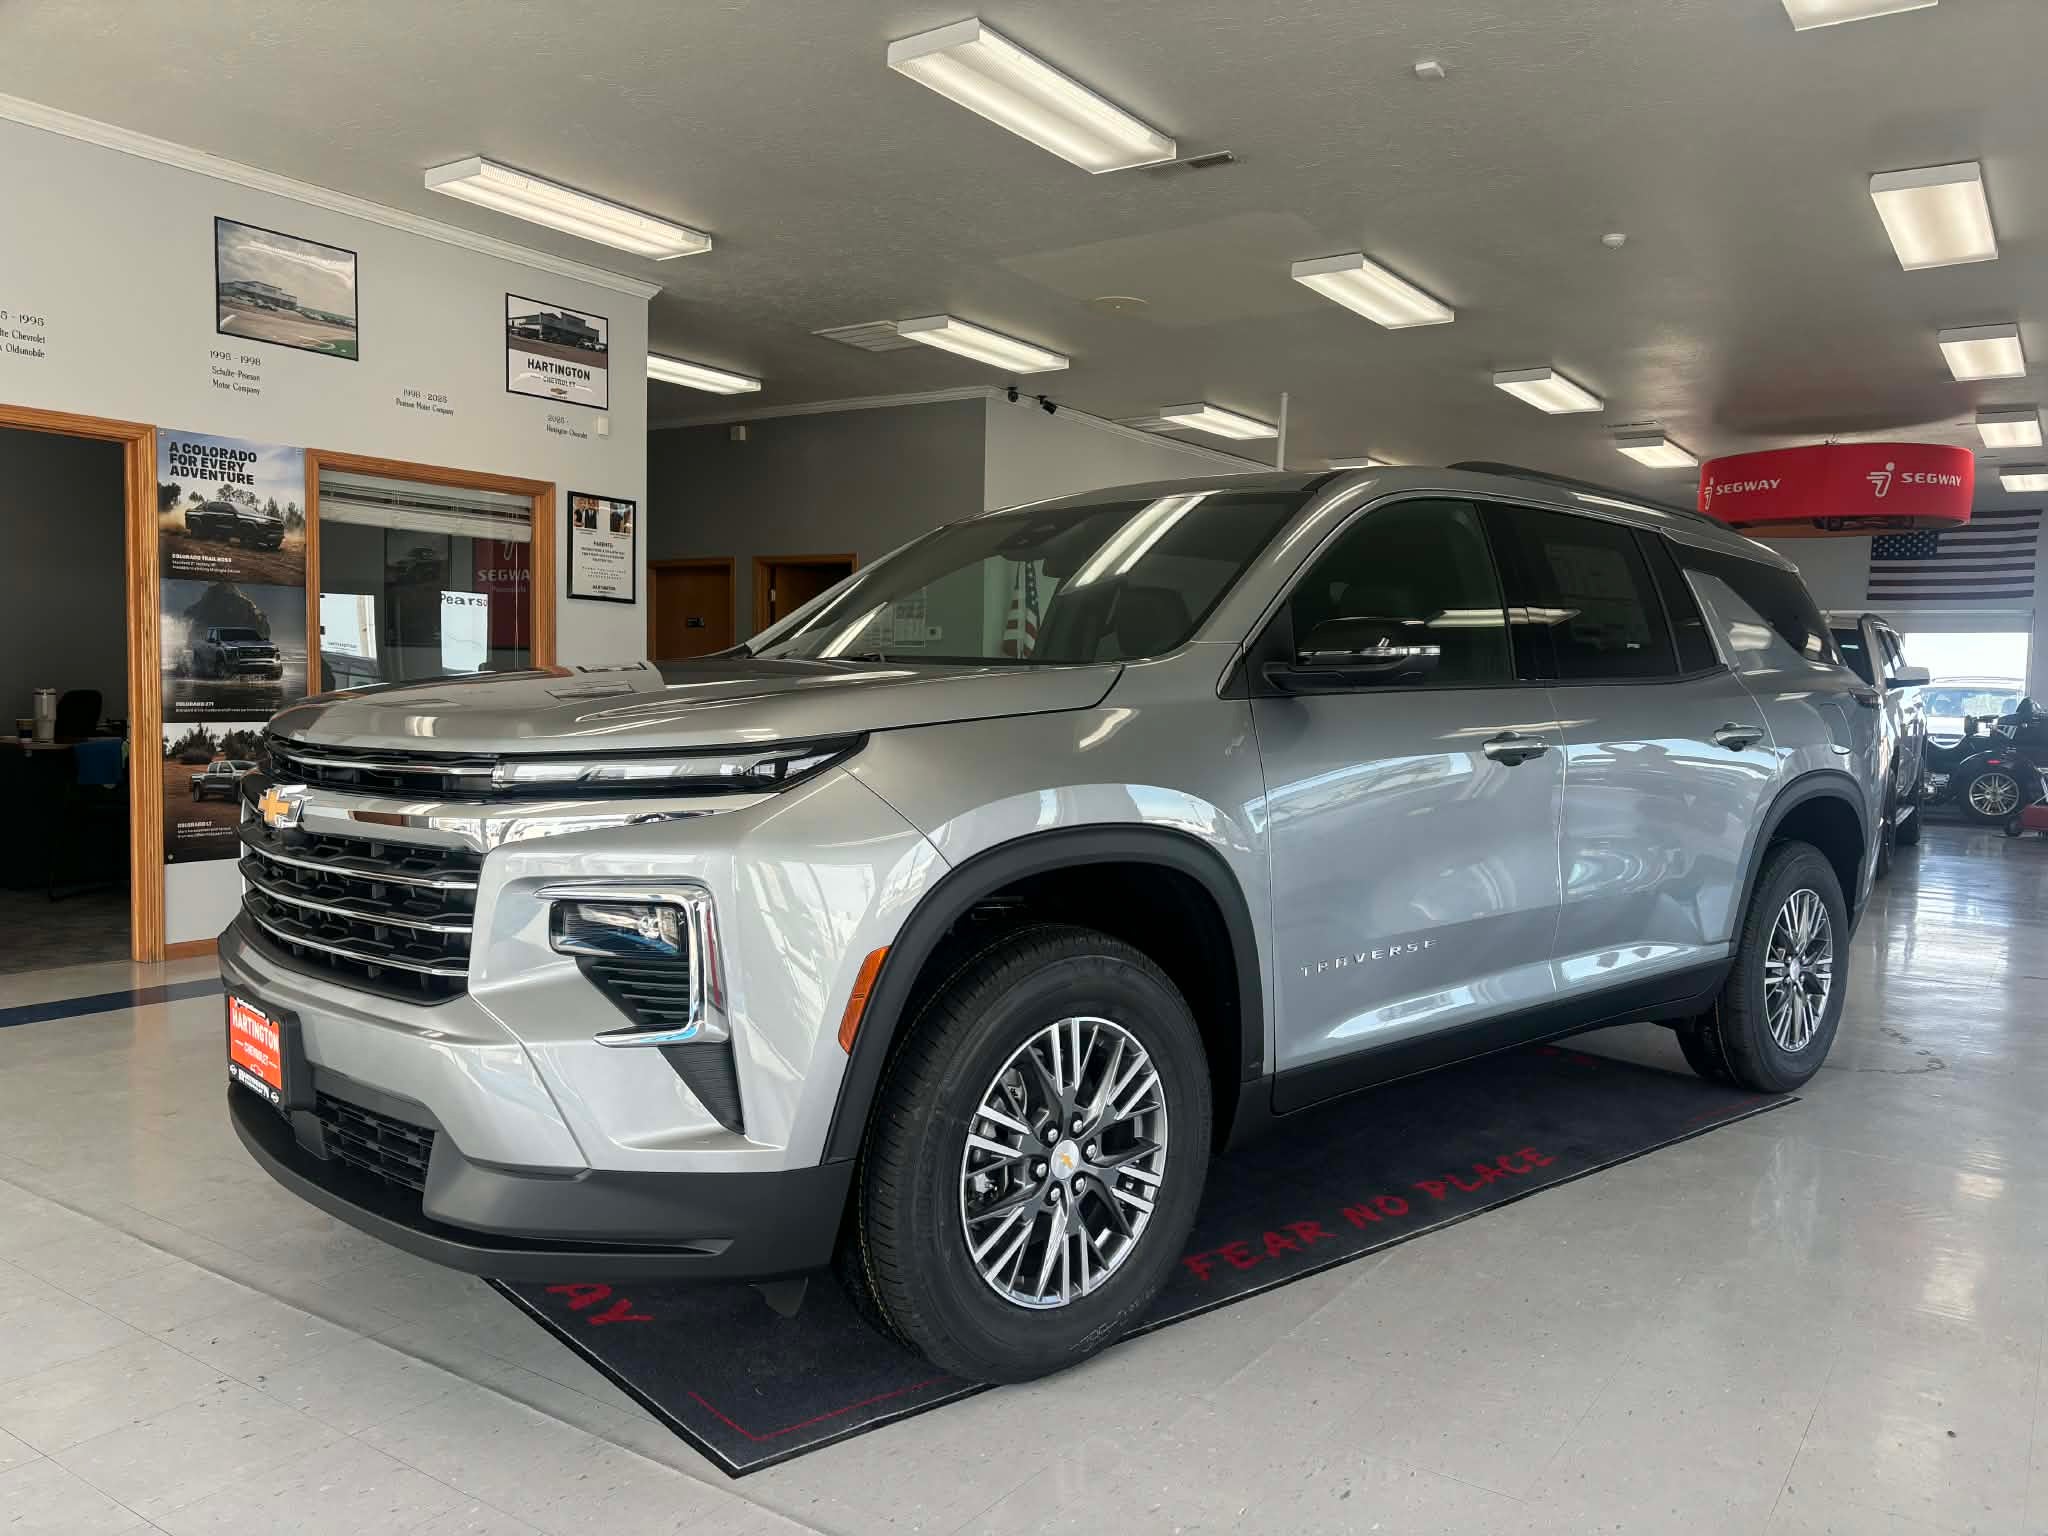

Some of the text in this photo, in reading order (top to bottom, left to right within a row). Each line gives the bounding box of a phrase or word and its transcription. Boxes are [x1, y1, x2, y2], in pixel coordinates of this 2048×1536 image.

[12, 329, 46, 344] Chevrolet
[527, 358, 591, 381] HARTINGTON
[543, 376, 576, 388] CHEVROLET
[169, 441, 257, 463] A COLORADO
[169, 453, 246, 473] FOR EVERY
[169, 466, 254, 486] ADVENTURE
[1901, 472, 1962, 487] SEGWAY
[1715, 478, 1782, 496] SEGWAY
[1300, 938, 1440, 977] TRAVERSE
[231, 1007, 280, 1054] HARTINGTON
[1181, 1146, 1558, 1281] FEAR NO PLACE
